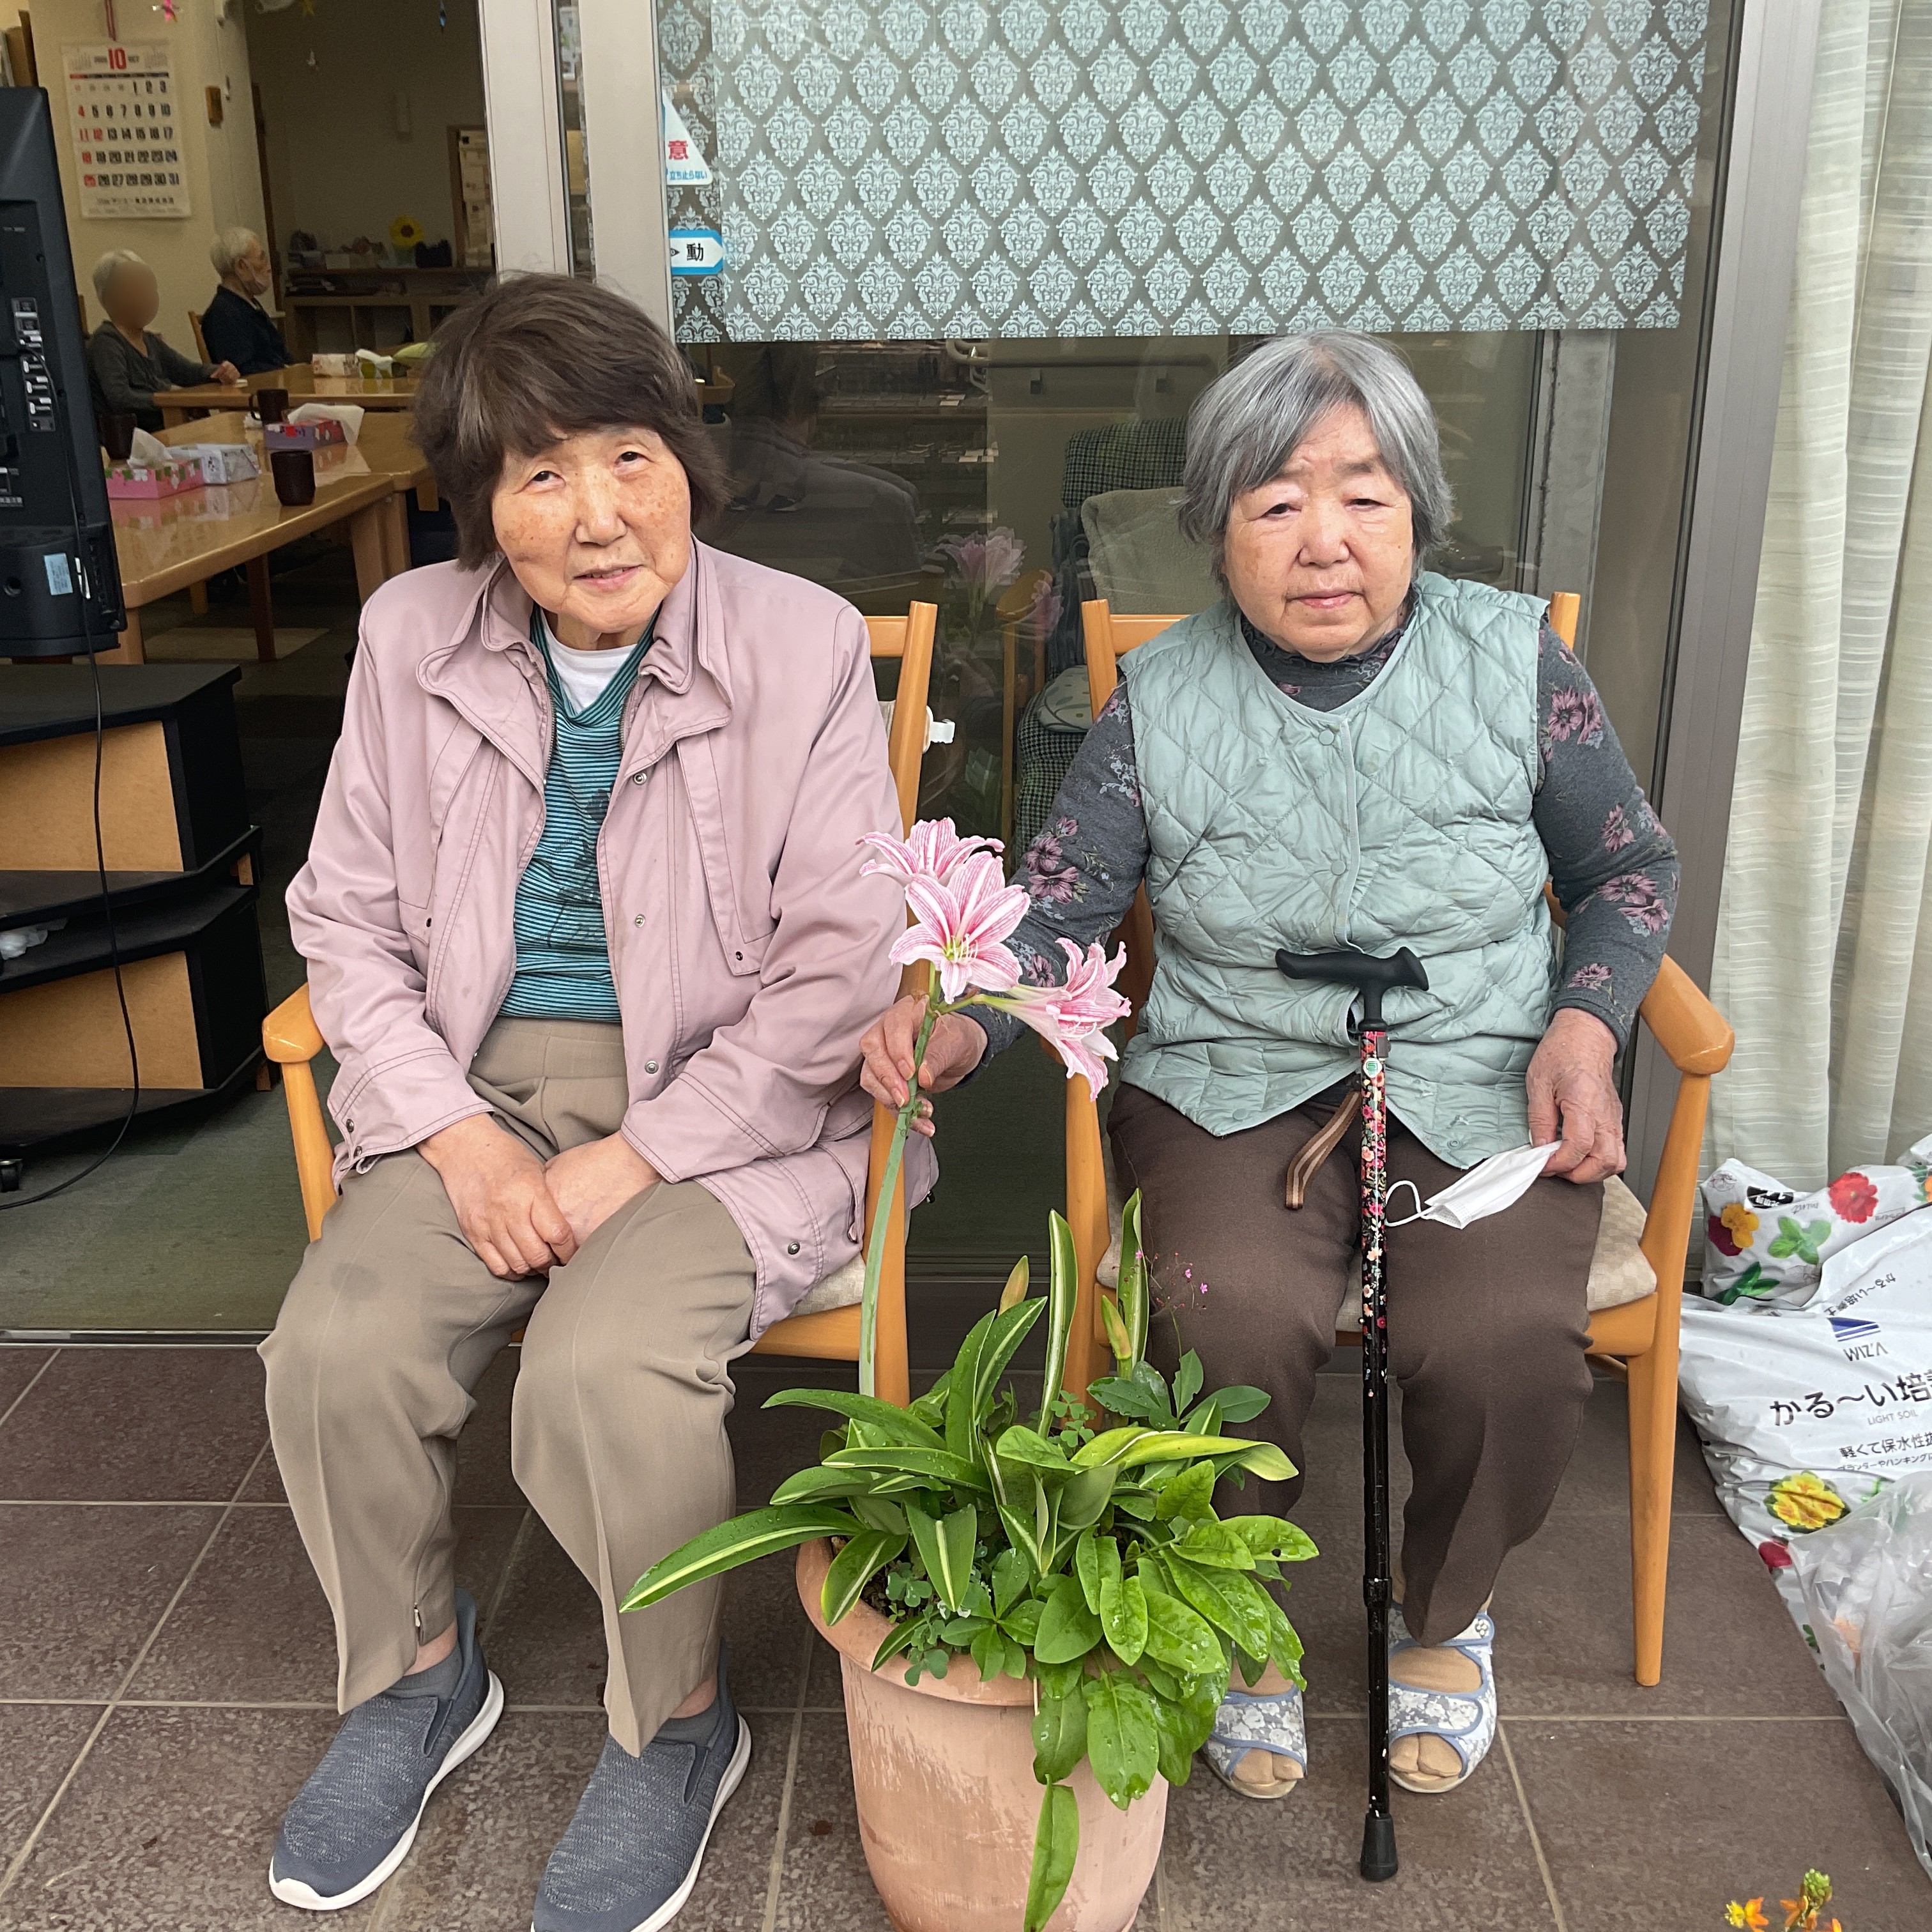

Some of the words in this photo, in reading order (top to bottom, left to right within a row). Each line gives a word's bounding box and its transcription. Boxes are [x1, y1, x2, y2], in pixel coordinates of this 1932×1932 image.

[109, 47, 126, 70] 10
[668, 140, 689, 160] 意
[686, 243, 704, 261] 動
[1867, 1412, 1895, 1425] LIGHT
[1897, 1409, 1918, 1420] SOIL
